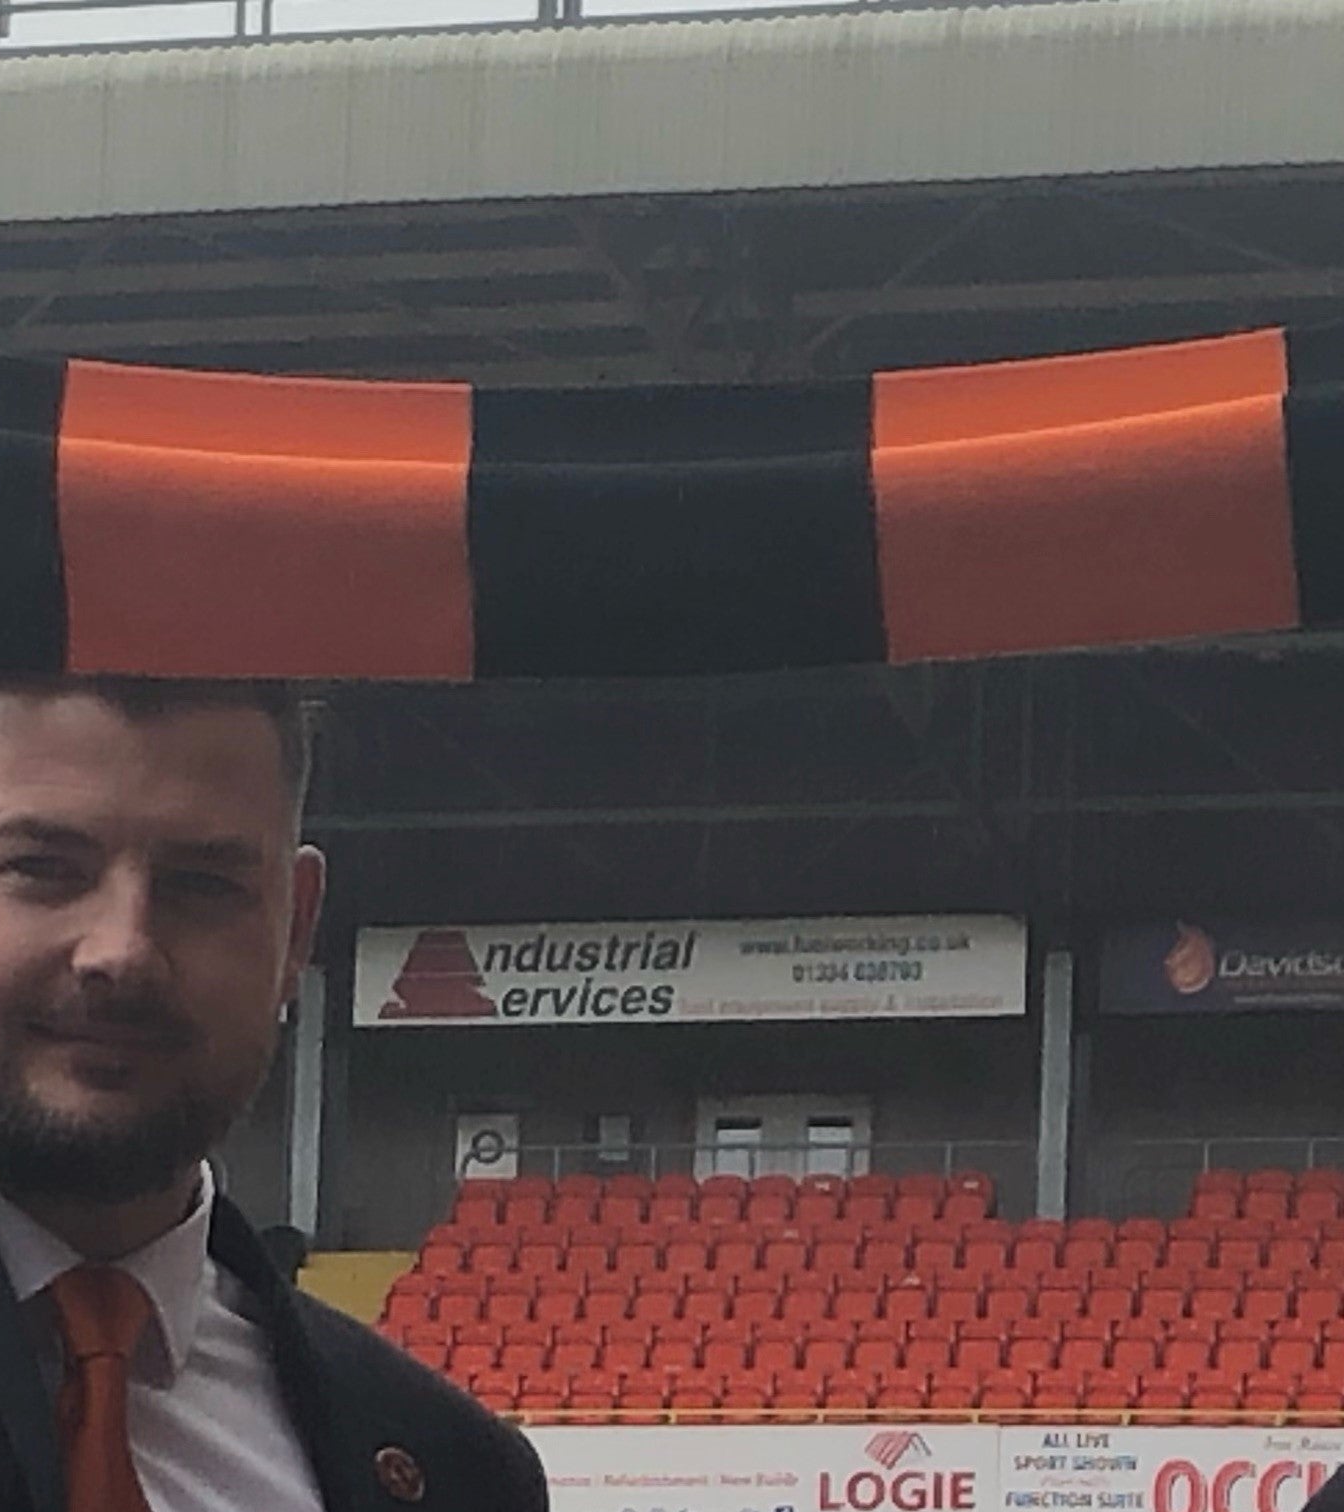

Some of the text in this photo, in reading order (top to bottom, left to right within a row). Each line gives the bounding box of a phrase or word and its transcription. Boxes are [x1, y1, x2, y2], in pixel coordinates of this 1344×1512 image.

[1042, 1432, 1110, 1449] ALL LIVE
[1014, 1456, 1066, 1471] SPORT
[818, 1471, 977, 1512] LOGIE
[1005, 1492, 1145, 1509] FUNCTION SUITE
